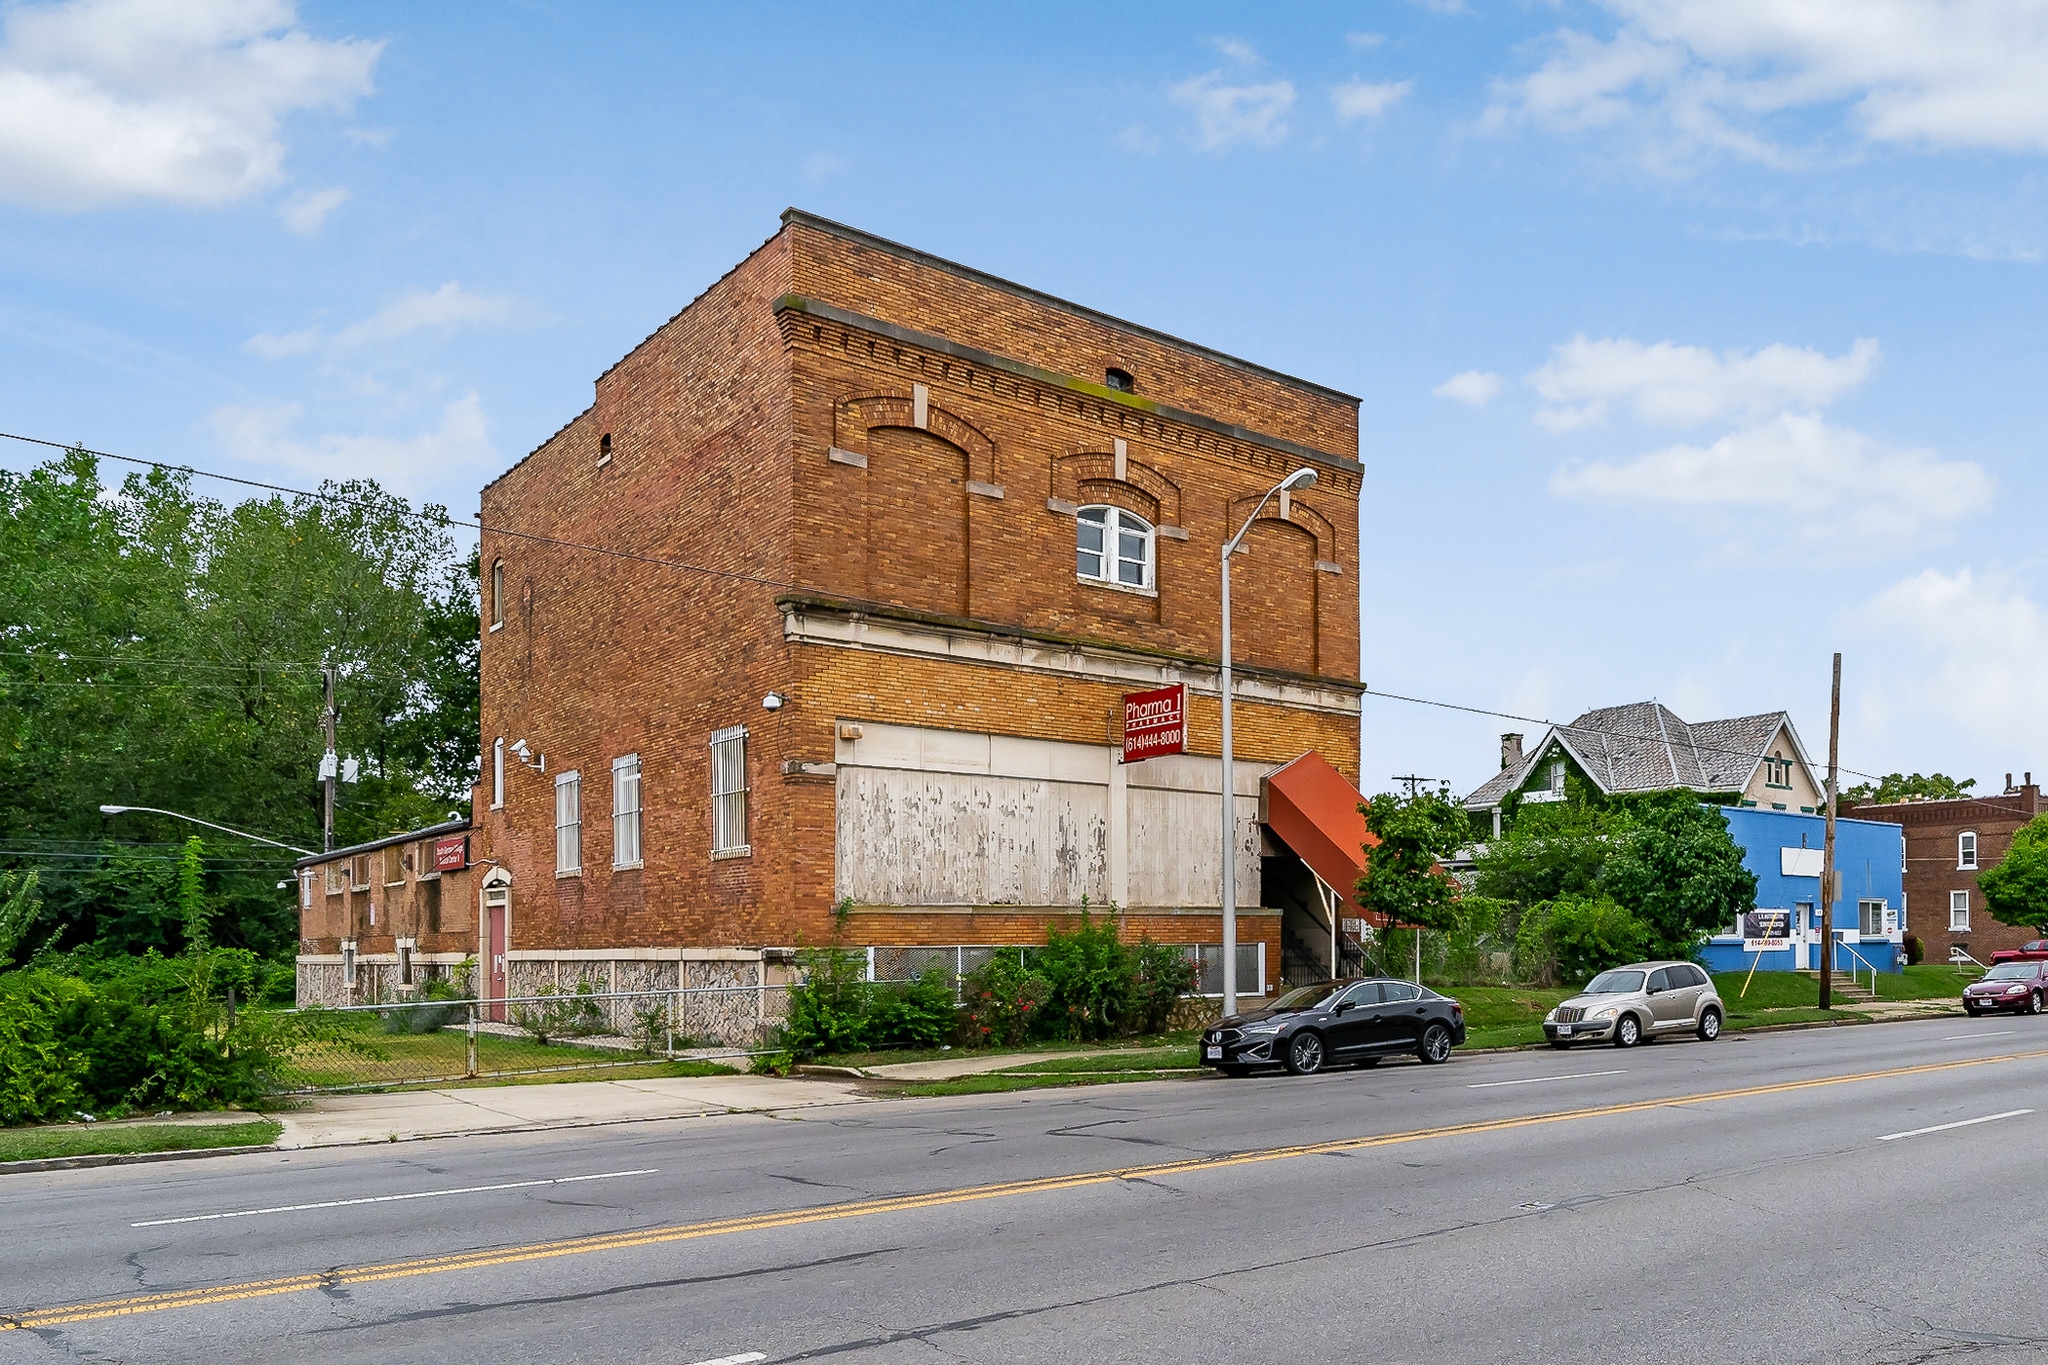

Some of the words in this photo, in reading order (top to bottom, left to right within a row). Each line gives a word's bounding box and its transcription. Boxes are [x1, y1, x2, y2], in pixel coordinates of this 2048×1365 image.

[1126, 699, 1172, 720] Pharma
[1176, 693, 1181, 711] 1
[1126, 714, 1181, 729] PHARMACY
[1125, 729, 1181, 753] (614)444-8000
